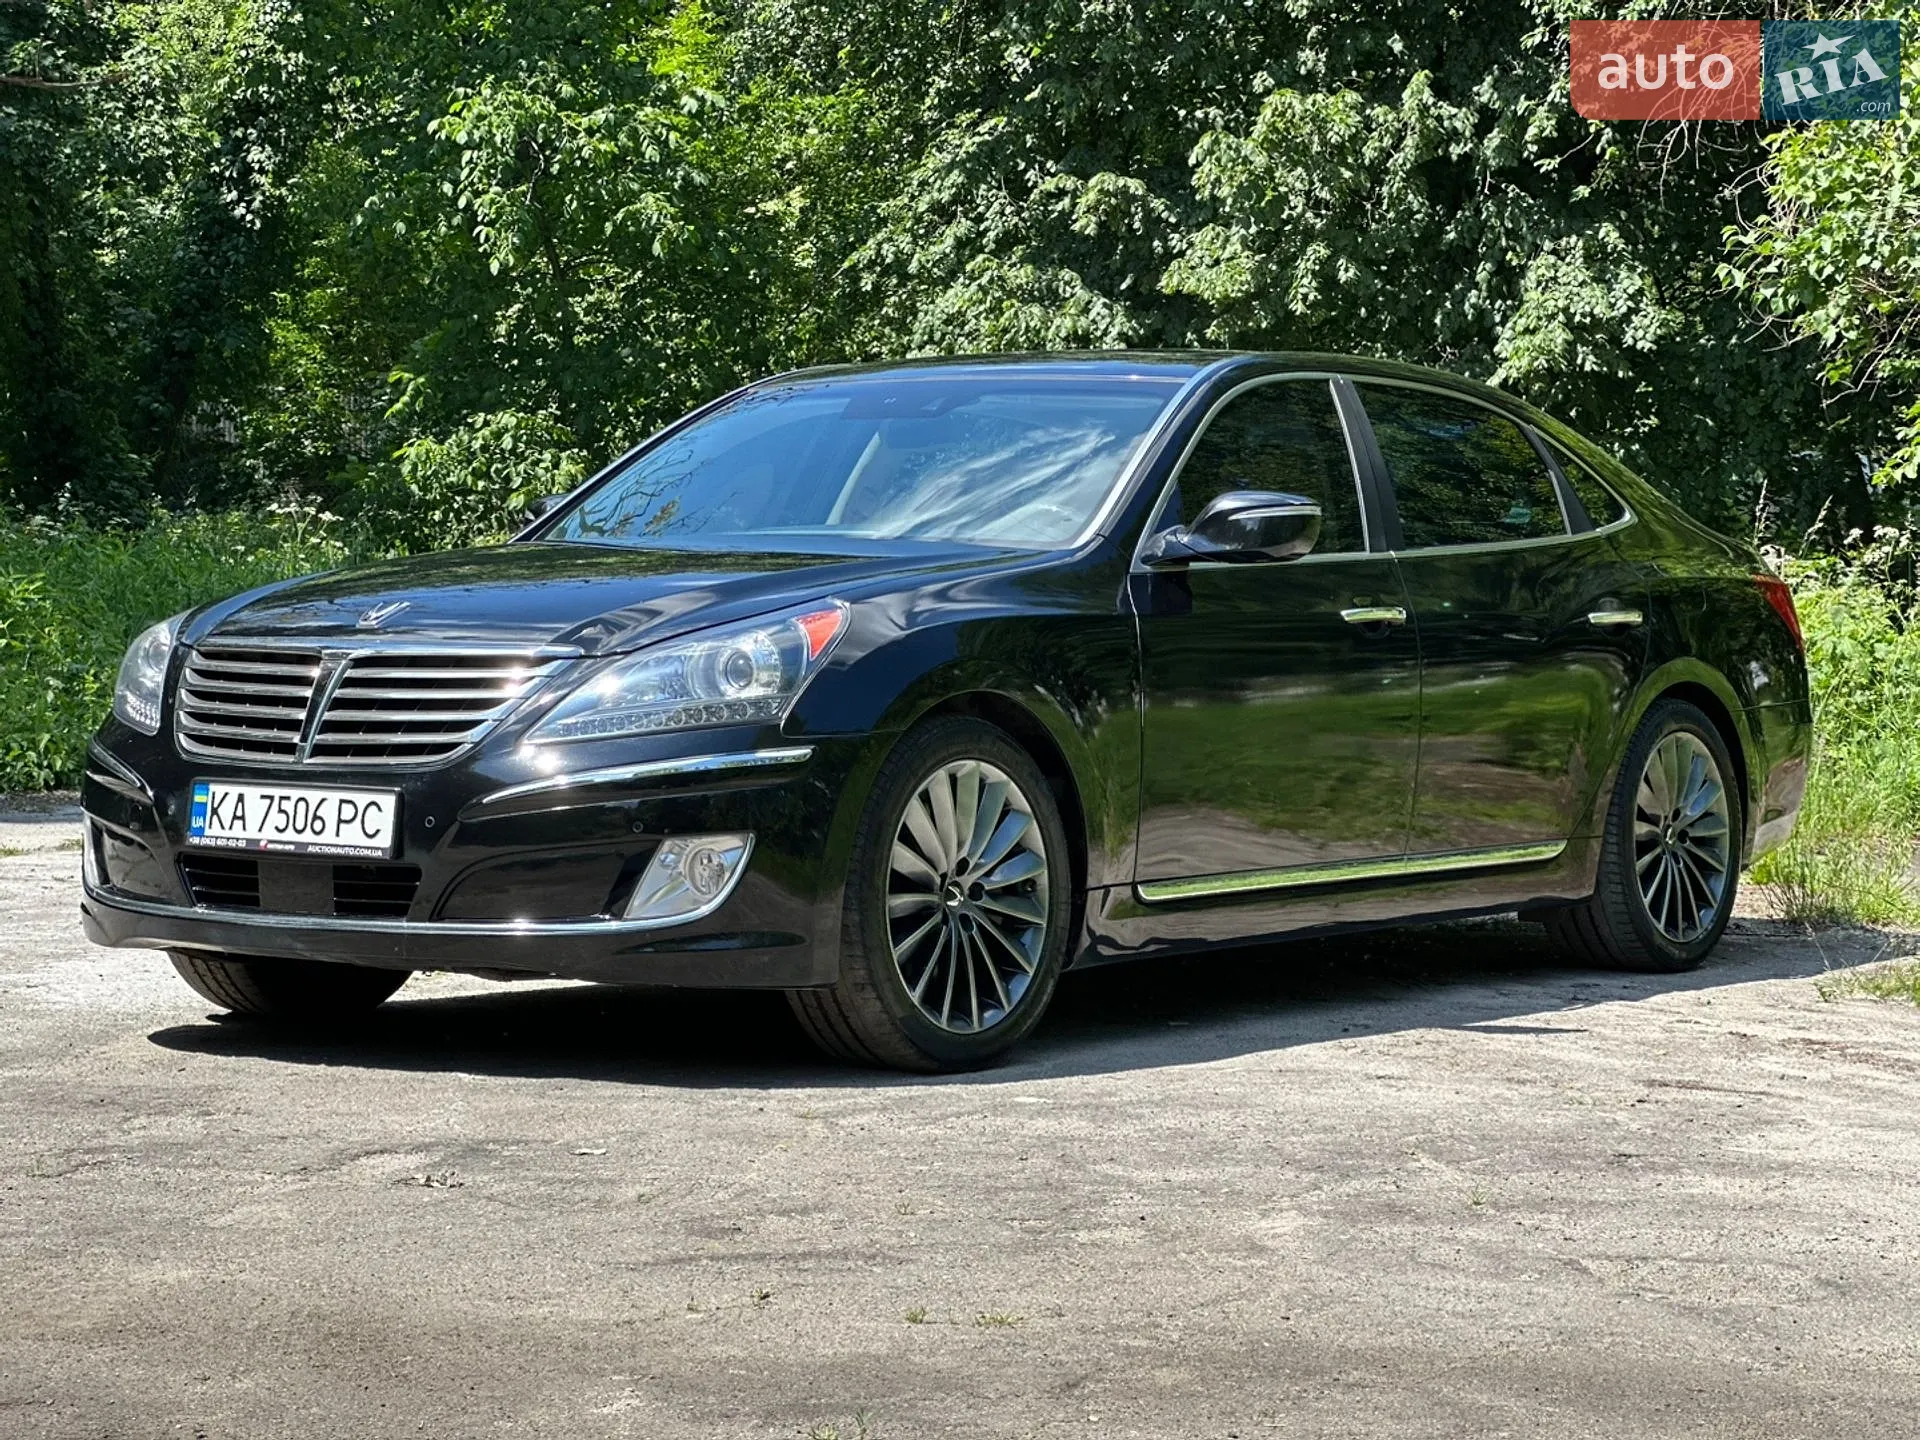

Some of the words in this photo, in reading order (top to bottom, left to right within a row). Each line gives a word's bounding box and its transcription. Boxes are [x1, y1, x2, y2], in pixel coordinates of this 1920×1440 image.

[208, 791, 247, 832] KA
[257, 795, 328, 836] 7506
[335, 798, 383, 840] PC
[191, 816, 204, 829] UA
[306, 844, 383, 857] AUCTIONAUTO.COM.UA
